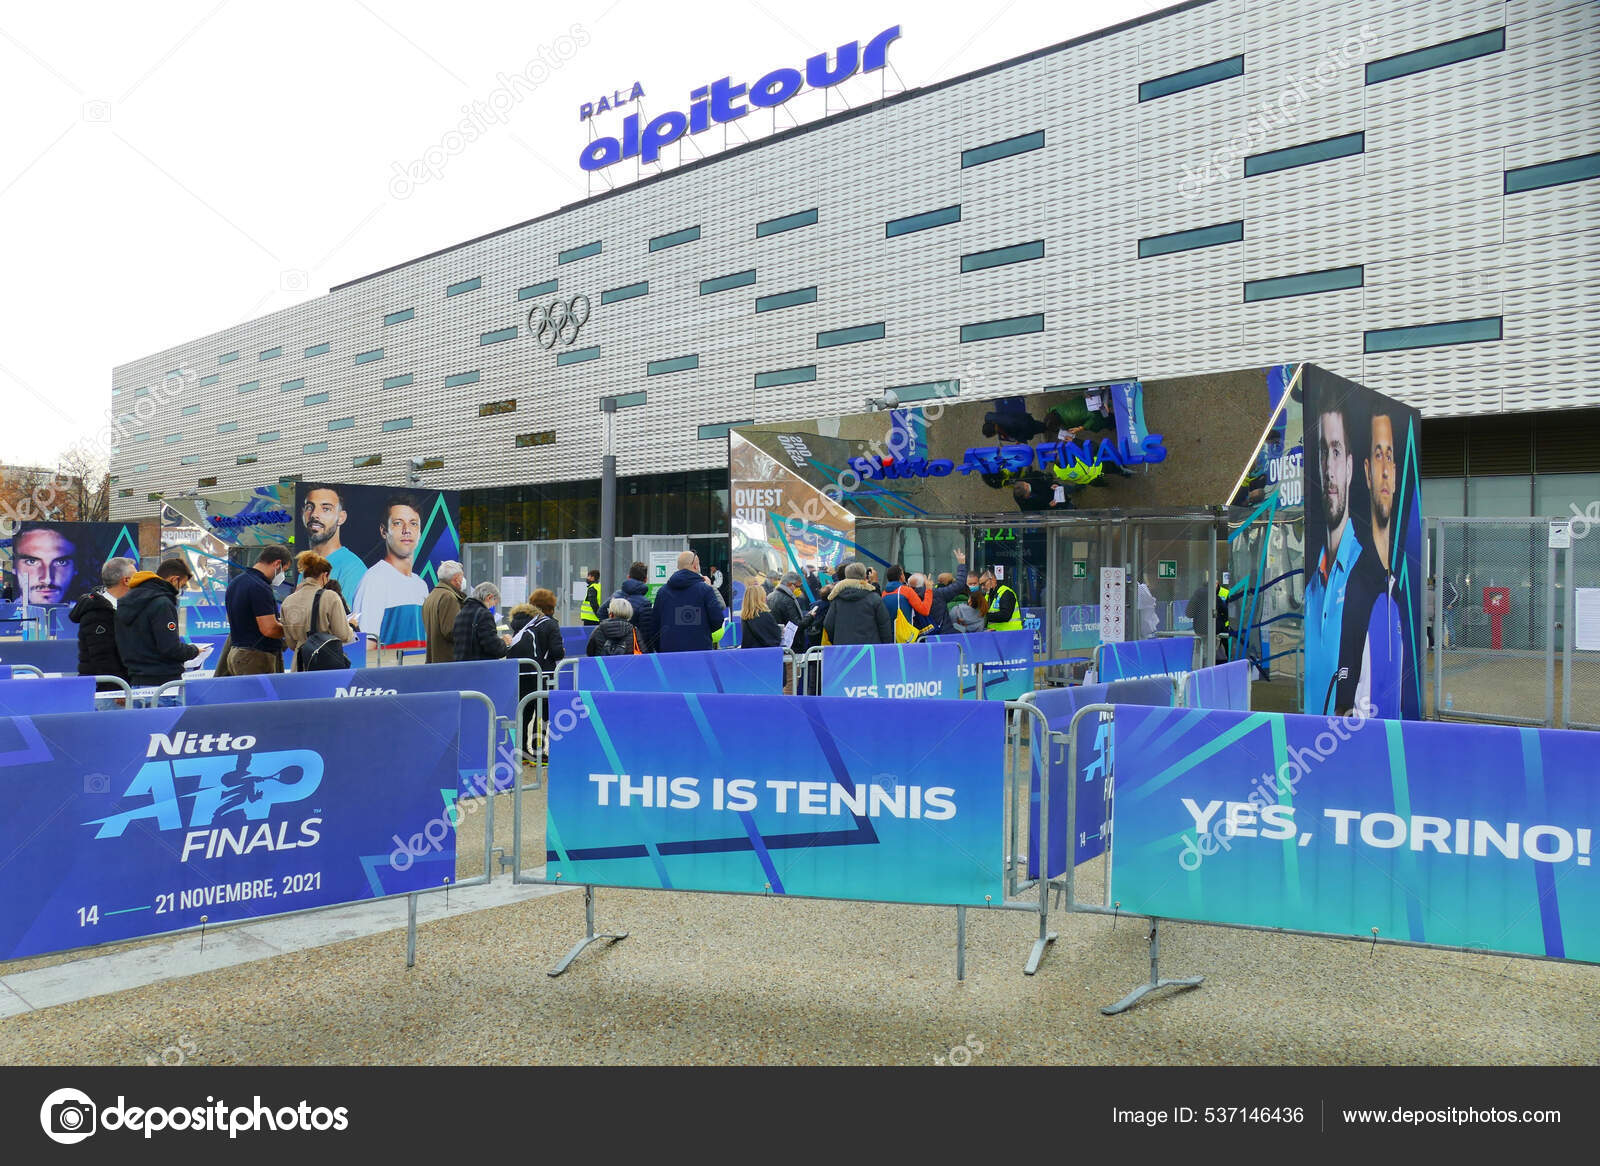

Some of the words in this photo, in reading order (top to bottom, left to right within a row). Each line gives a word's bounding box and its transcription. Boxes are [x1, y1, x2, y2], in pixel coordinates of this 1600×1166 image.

[579, 24, 902, 171] alpitour
[955, 444, 1034, 475] ATP
[1036, 434, 1167, 470] FINALS
[1269, 452, 1303, 482] OVEST
[735, 489, 783, 507] OVEST
[1280, 480, 1302, 506] SUD
[735, 507, 766, 525] SUD
[195, 620, 221, 629] THIS
[885, 680, 942, 699] TORINO!
[146, 731, 256, 757] Nitto
[80, 749, 324, 840] ATP
[589, 773, 700, 809] THIS
[713, 778, 757, 811] IS
[766, 779, 957, 820] TENNIS
[181, 818, 322, 862] FINALS
[1181, 798, 1313, 847] YES,
[1323, 808, 1592, 866] TORINO!
[77, 905, 99, 927] 14
[155, 893, 175, 914] 21
[180, 879, 277, 910] NOVEMBRE,
[282, 872, 321, 894] 2021
